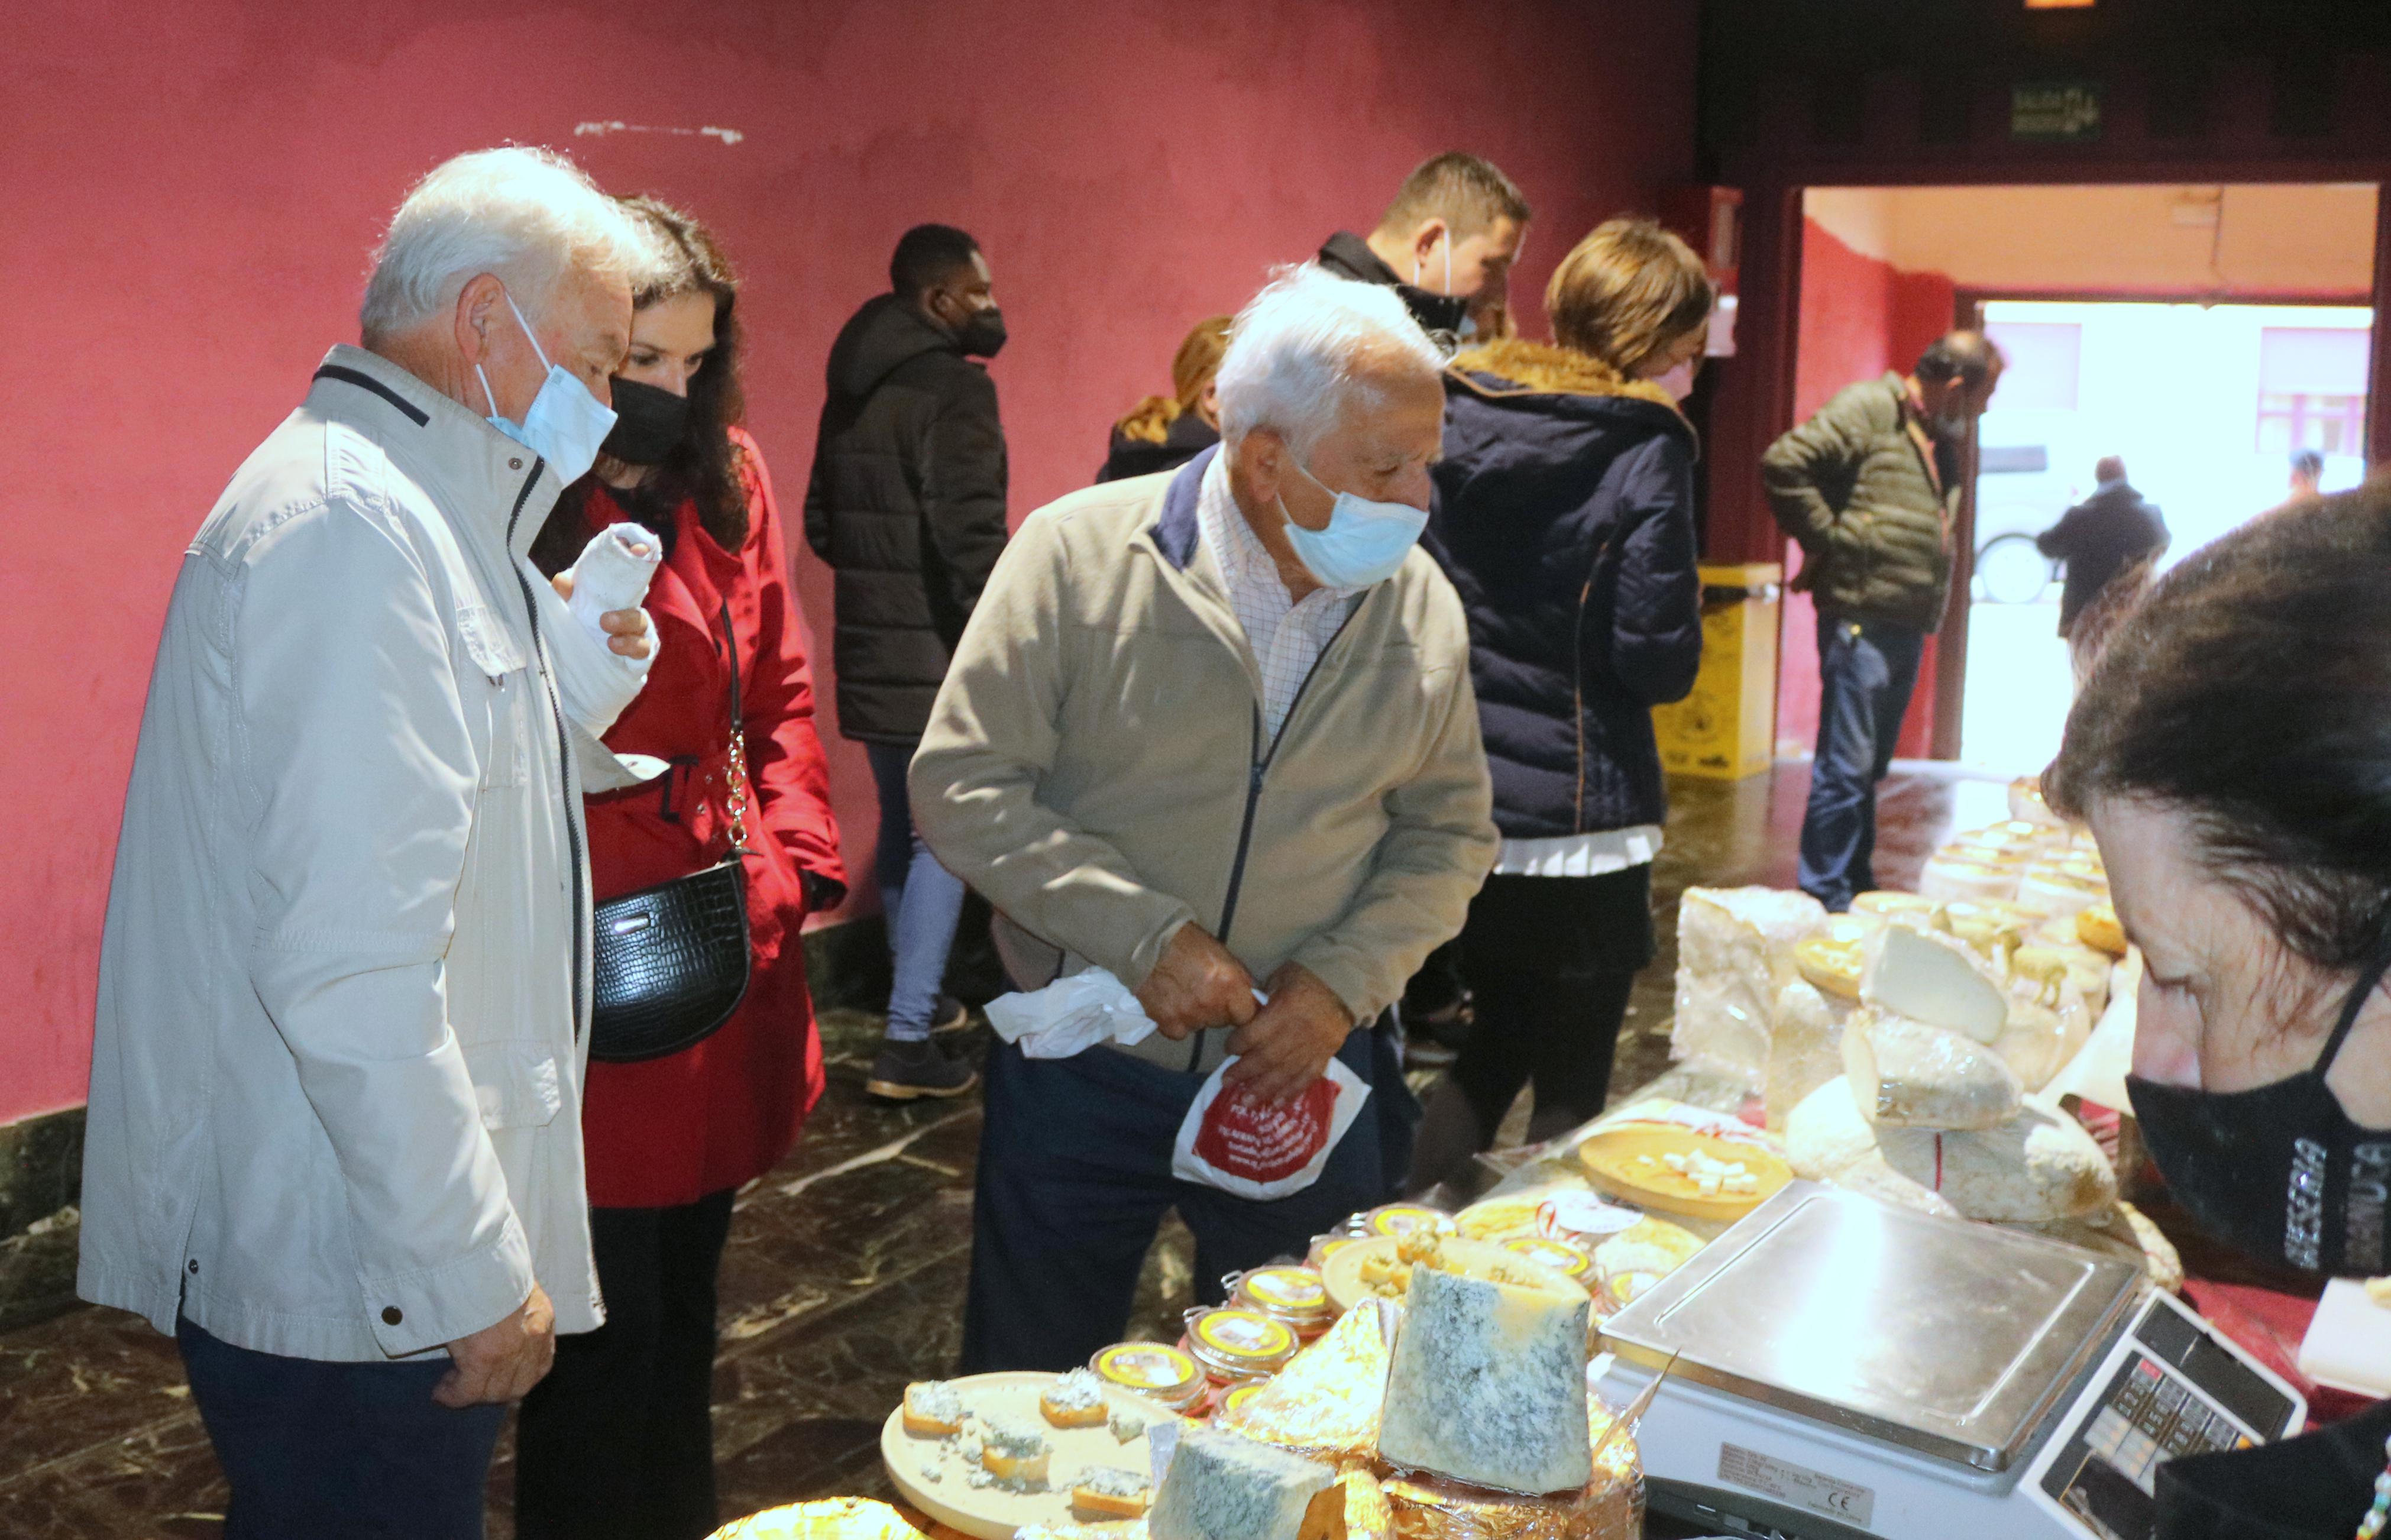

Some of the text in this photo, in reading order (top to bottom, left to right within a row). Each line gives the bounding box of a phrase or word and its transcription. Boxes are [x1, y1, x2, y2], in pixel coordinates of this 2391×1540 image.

[2124, 1392, 2139, 1406] 2
[2149, 1410, 2163, 1425] 5
[1828, 1492, 1850, 1510] CE
